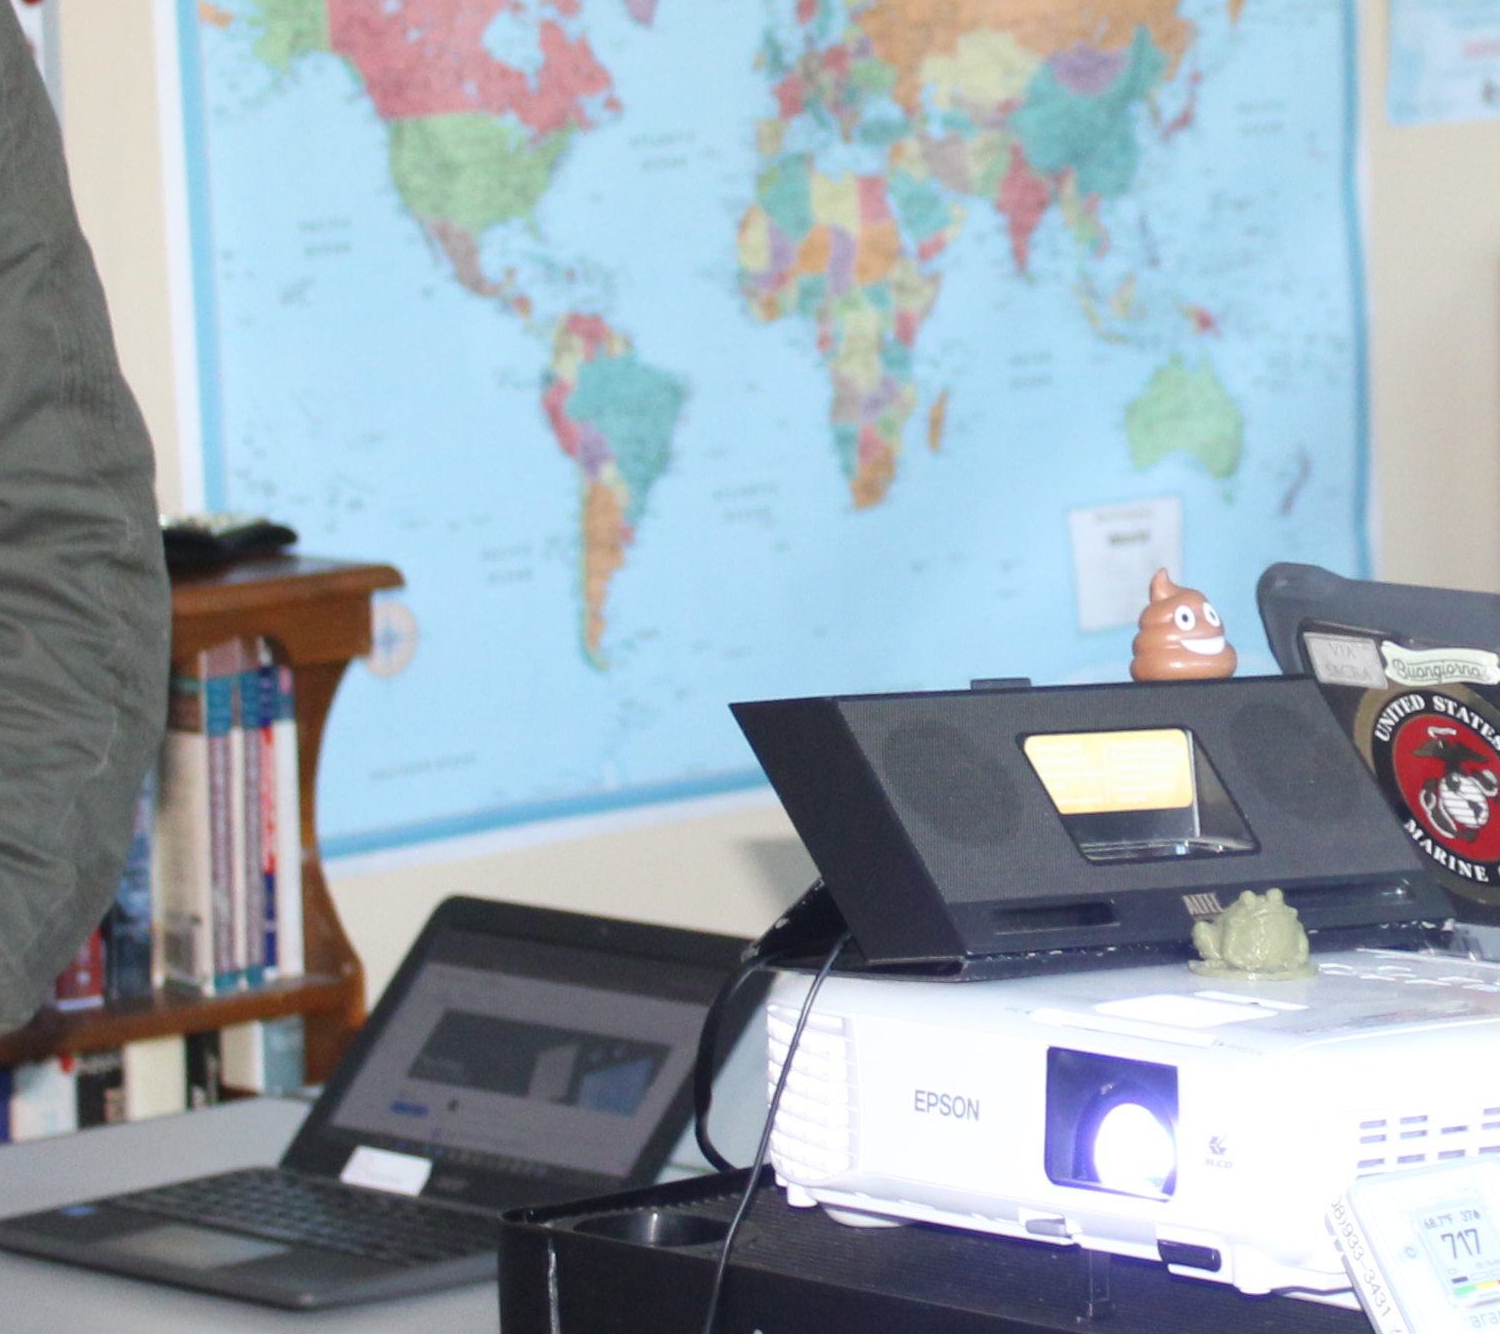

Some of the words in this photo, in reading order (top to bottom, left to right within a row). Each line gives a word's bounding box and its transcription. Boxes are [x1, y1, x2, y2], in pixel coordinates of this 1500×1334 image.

[1391, 658, 1483, 684] Buongiorno
[1374, 693, 1426, 743] UNITED
[1404, 818, 1490, 883] MARINE
[913, 1088, 981, 1122] EPSON
[1440, 1228, 1481, 1260] 717
